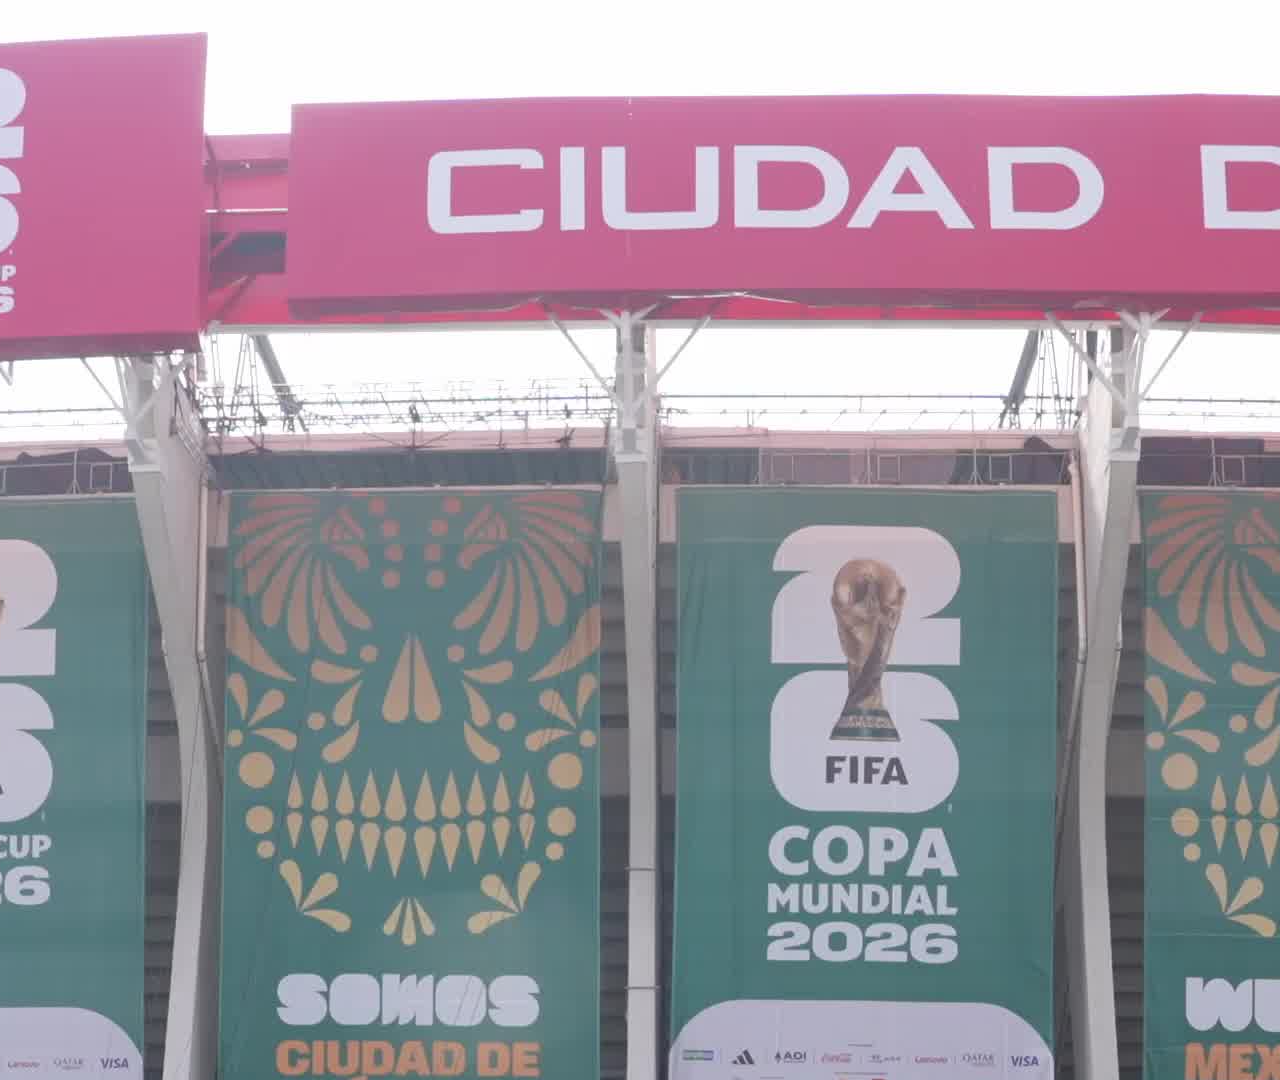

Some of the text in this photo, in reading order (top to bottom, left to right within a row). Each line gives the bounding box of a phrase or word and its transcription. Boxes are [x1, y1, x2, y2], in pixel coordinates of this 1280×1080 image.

[426, 145, 1107, 234] CIUDAD
[824, 755, 909, 785] FIFA
[767, 825, 960, 877] COPA
[766, 882, 959, 916] MUNDIAL
[766, 921, 960, 964] 2026
[276, 973, 542, 1027] SOMOS
[100, 1057, 129, 1069] VISA
[275, 1040, 541, 1078] CIUDAD DE
[1011, 1055, 1040, 1067] VISA
